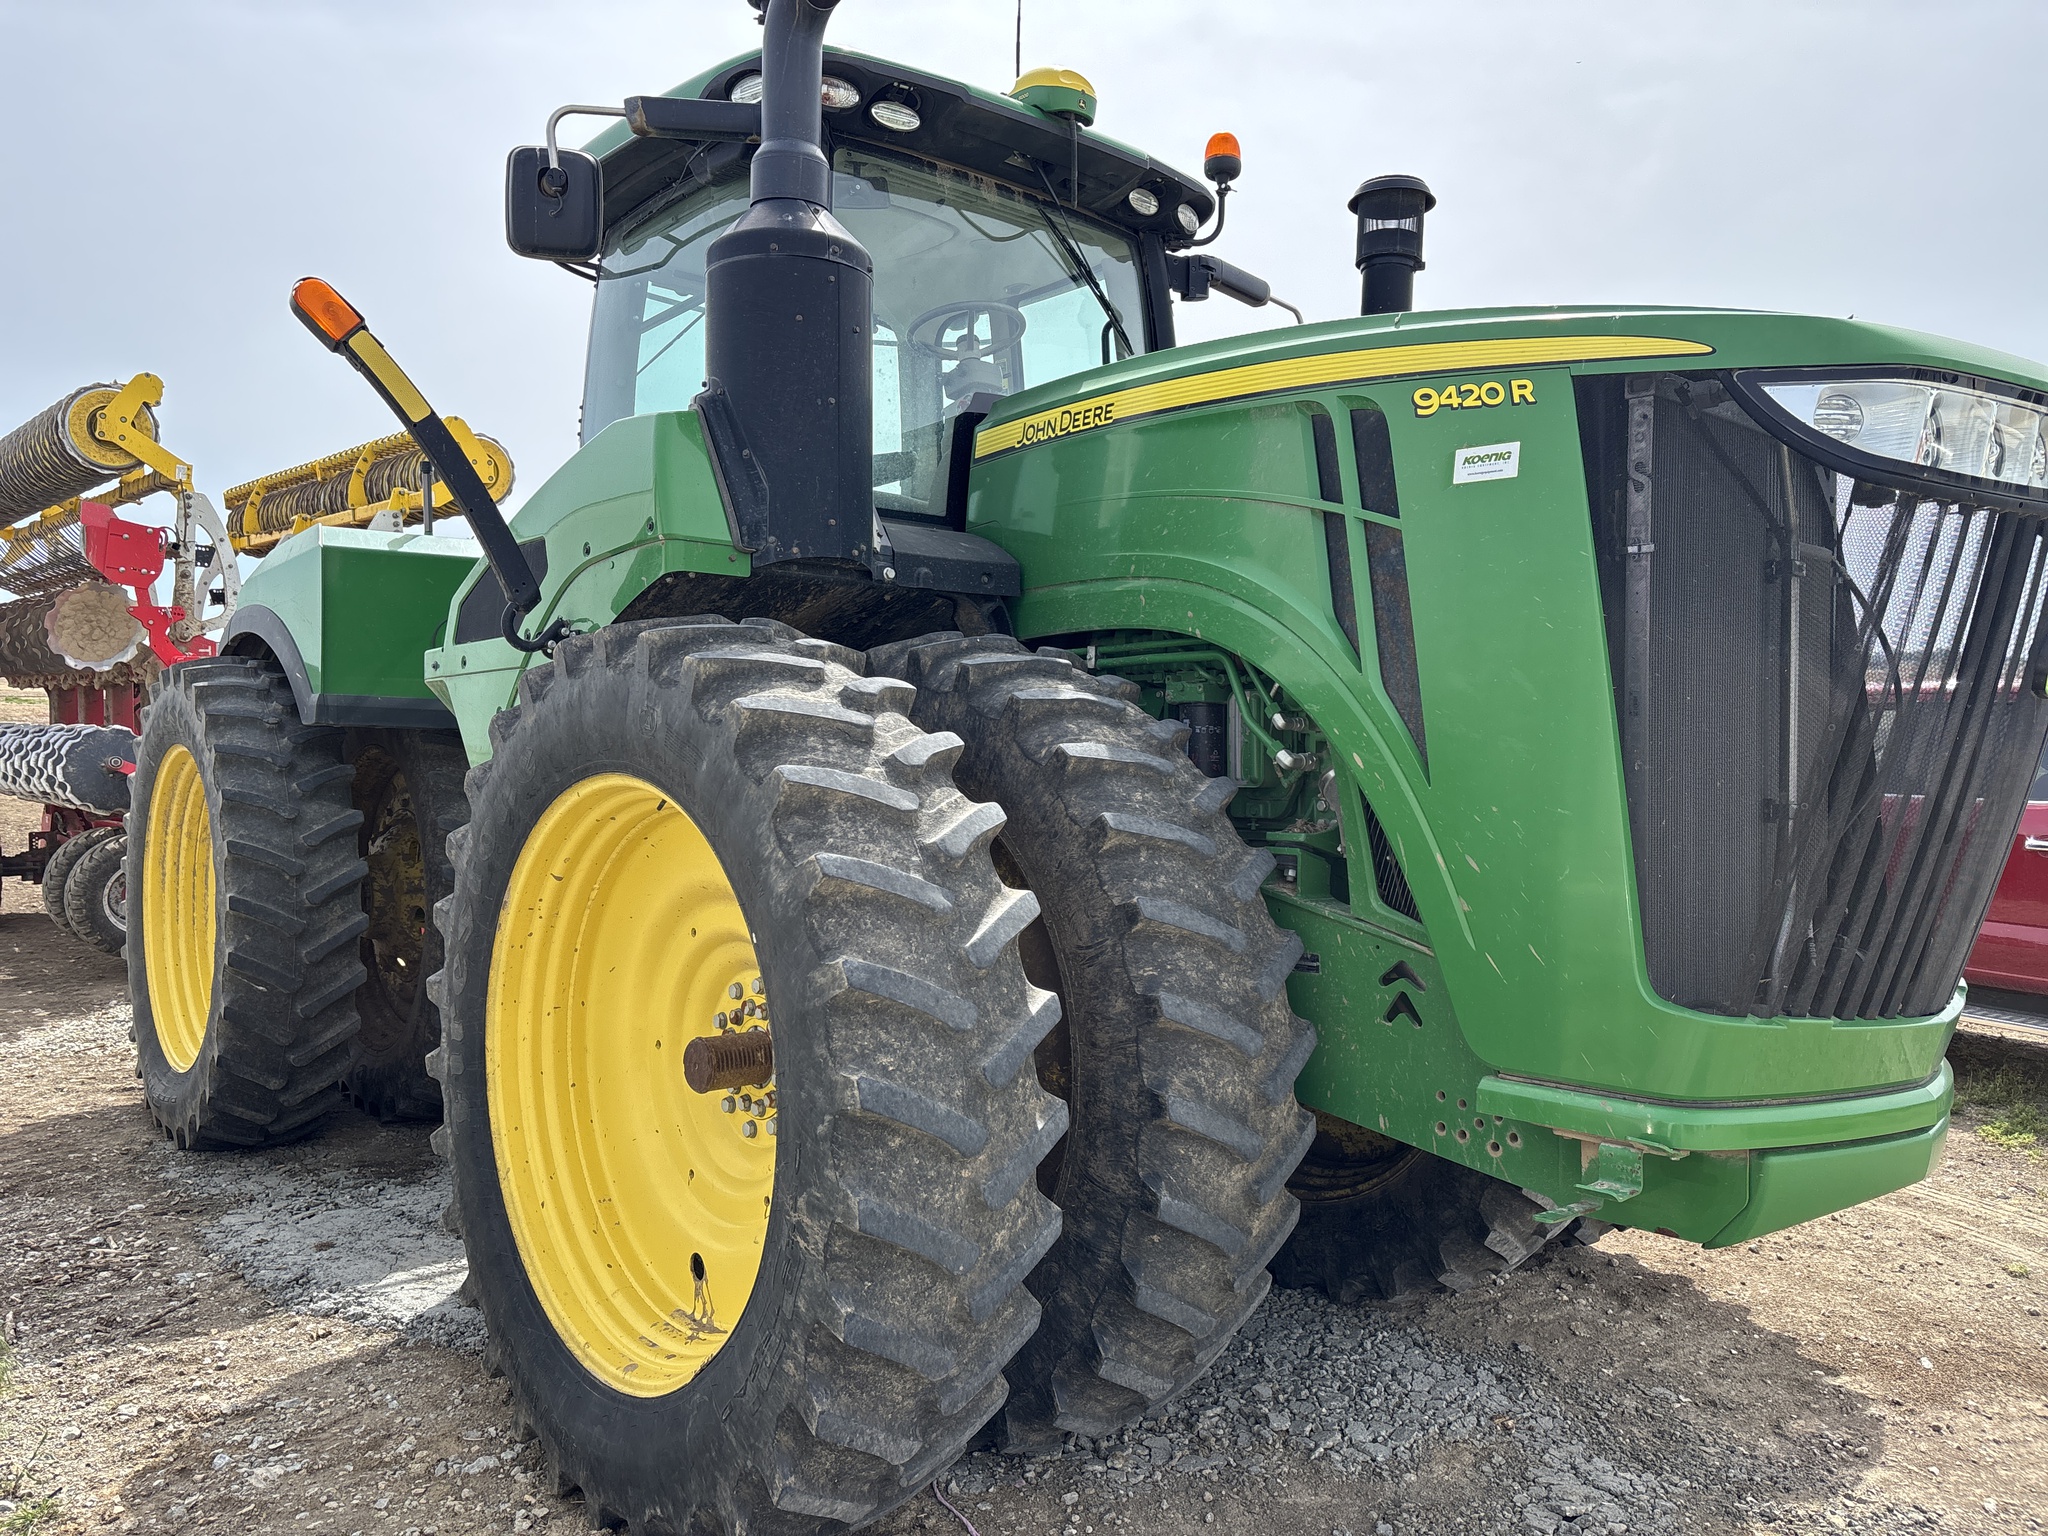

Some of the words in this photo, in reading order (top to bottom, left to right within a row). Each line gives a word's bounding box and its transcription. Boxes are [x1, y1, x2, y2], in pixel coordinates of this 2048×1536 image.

[1412, 381, 1505, 418] 9420
[1015, 417, 1057, 446] JOHN
[1060, 403, 1115, 432] DEERE
